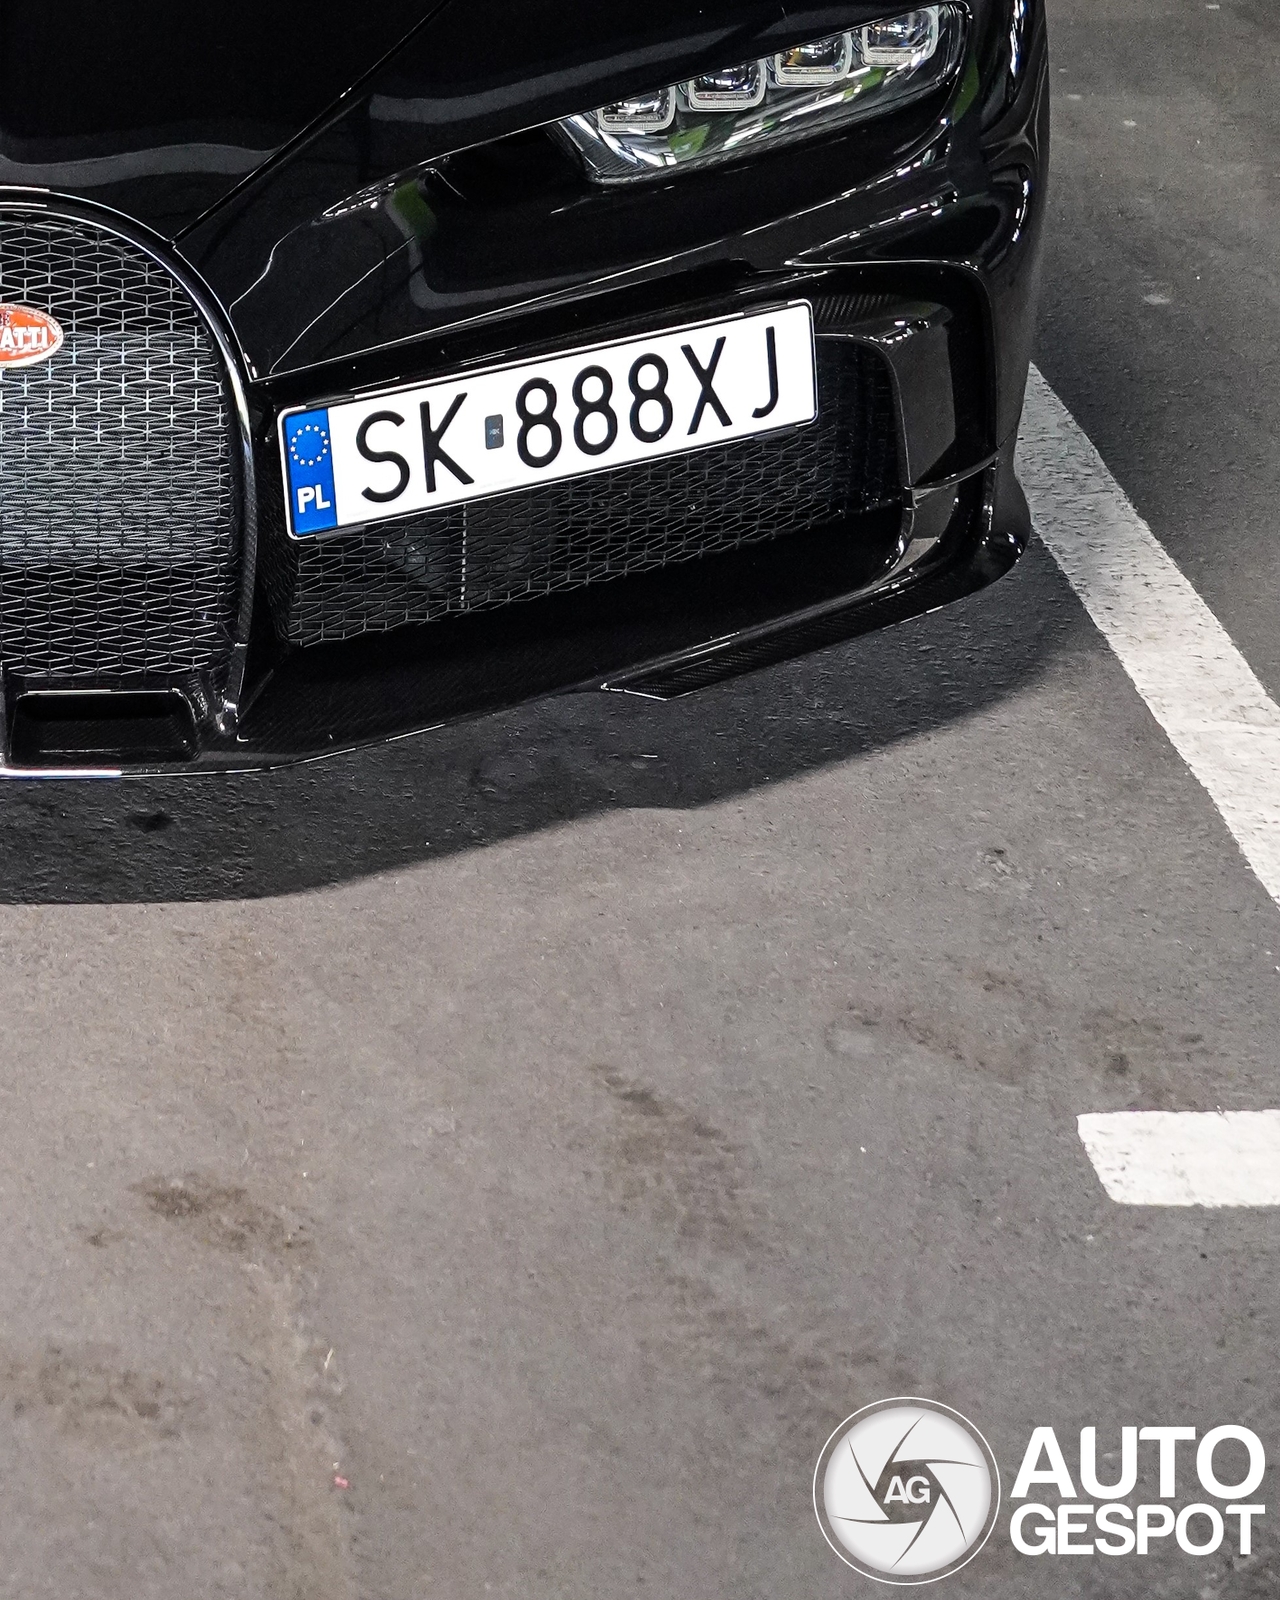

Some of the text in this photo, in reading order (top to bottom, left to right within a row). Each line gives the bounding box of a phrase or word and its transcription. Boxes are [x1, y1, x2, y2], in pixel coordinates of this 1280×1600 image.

[356, 326, 780, 503] SK 888XJ
[297, 484, 331, 513] PL
